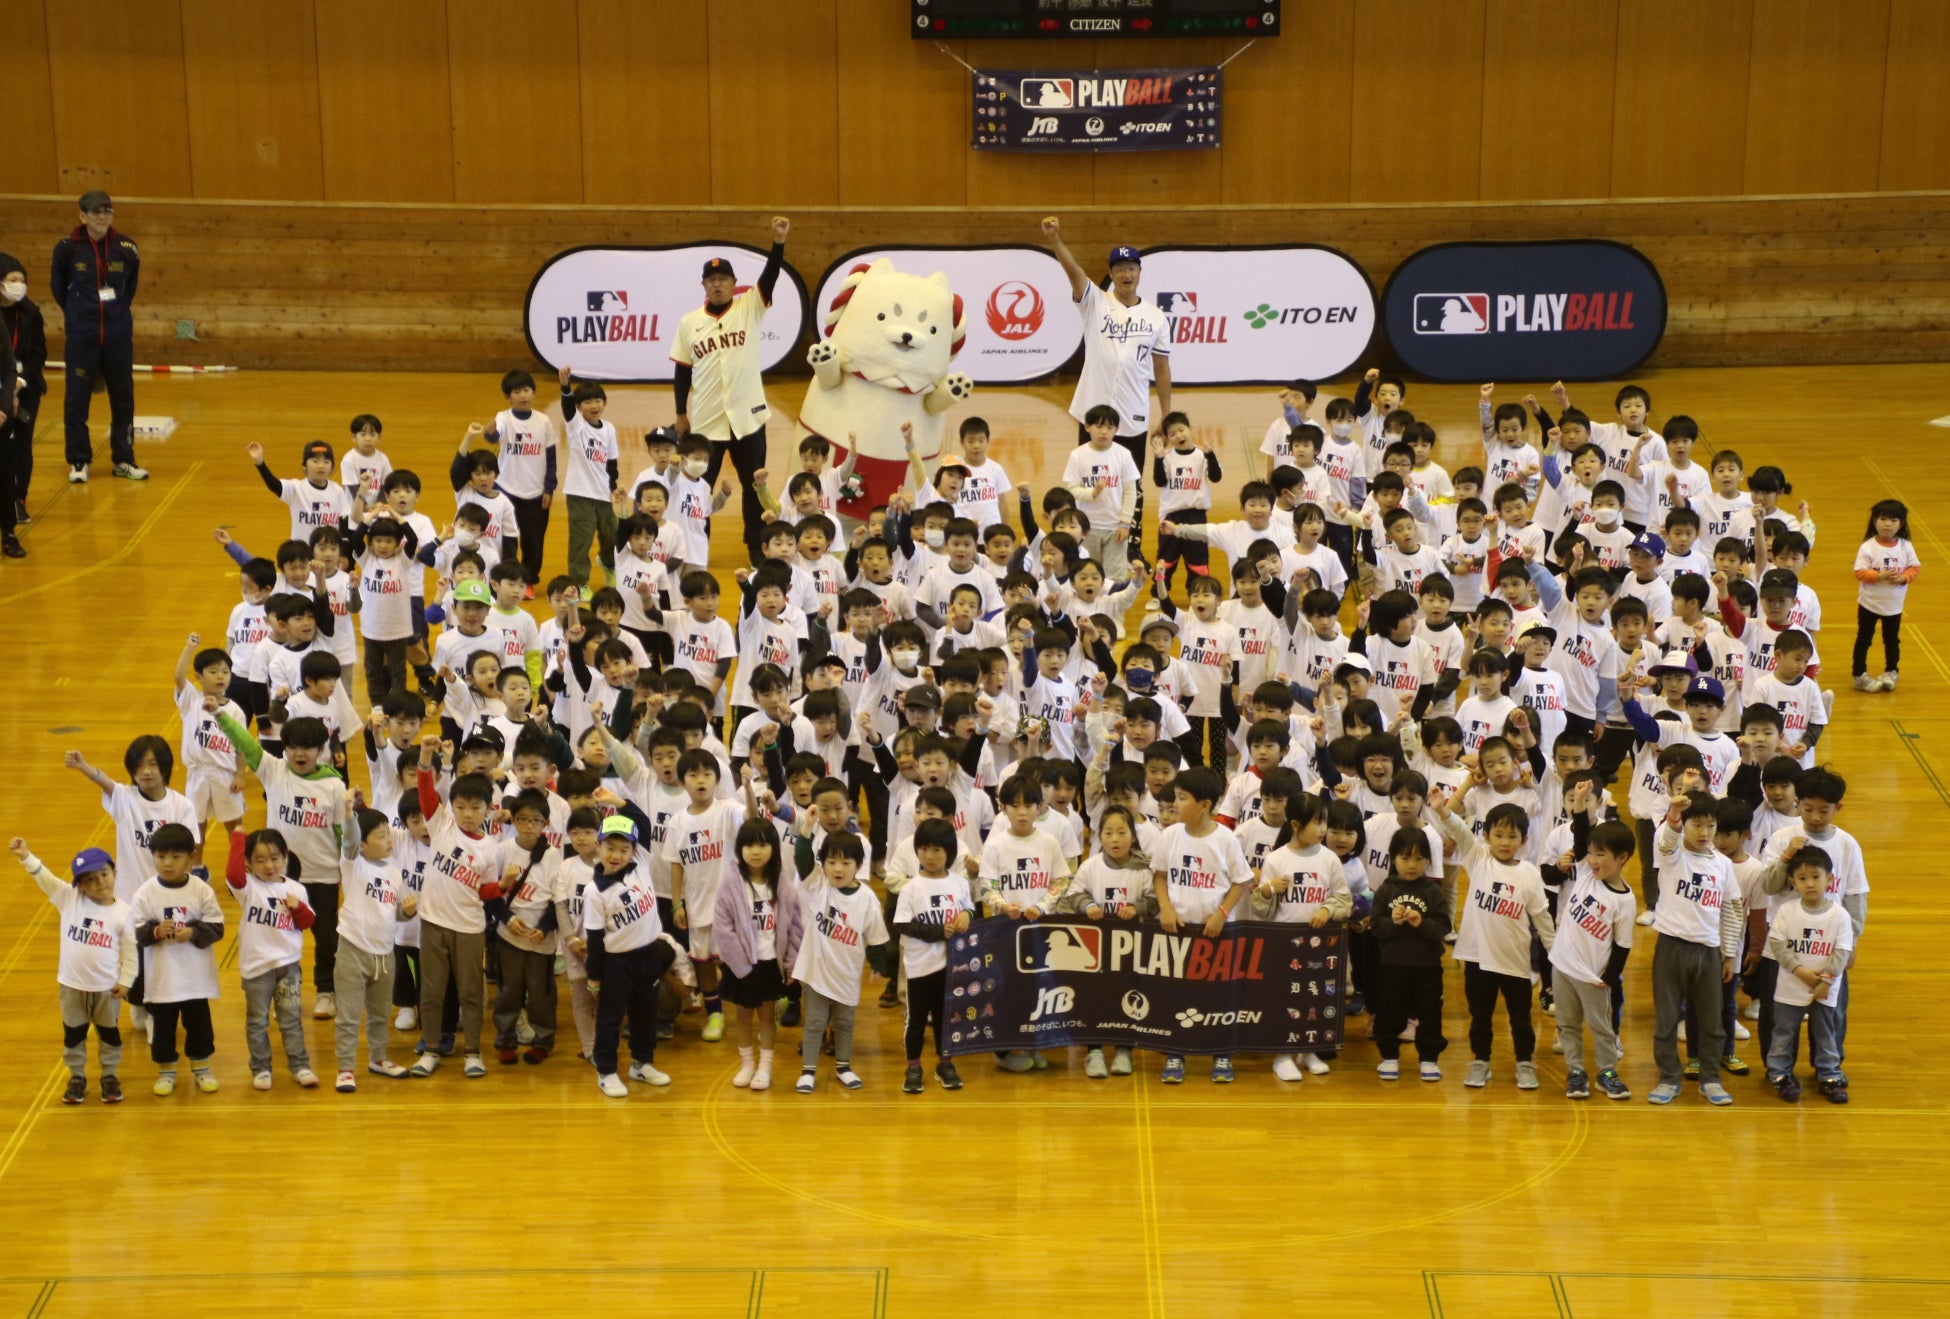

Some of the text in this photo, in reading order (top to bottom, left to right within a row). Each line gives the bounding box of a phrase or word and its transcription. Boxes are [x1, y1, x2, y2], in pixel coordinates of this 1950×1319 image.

[1070, 19, 1121, 31] CITIZEN
[1078, 77, 1172, 107] PLAYBALL
[1027, 117, 1059, 136] JTB
[1119, 246, 1129, 257] KC
[1497, 292, 1634, 332] PLAYBALL
[556, 314, 660, 344] PLAYBALL
[1001, 322, 1033, 334] JAL
[1100, 314, 1153, 343] Royals
[1165, 316, 1228, 344] BALL
[693, 330, 746, 359] GIANTS
[1136, 344, 1150, 361] 17
[1375, 671, 1417, 691] PLAYBALL
[1697, 677, 1708, 690] LA
[279, 803, 328, 829] PLAYBALL
[1474, 889, 1523, 920] PLAYBALL
[67, 924, 111, 949] PLAYBALL
[1110, 929, 1264, 981] PLAYBALL
[1029, 985, 1076, 1021] JTB
[1129, 1024, 1172, 1037] AIRLINES
